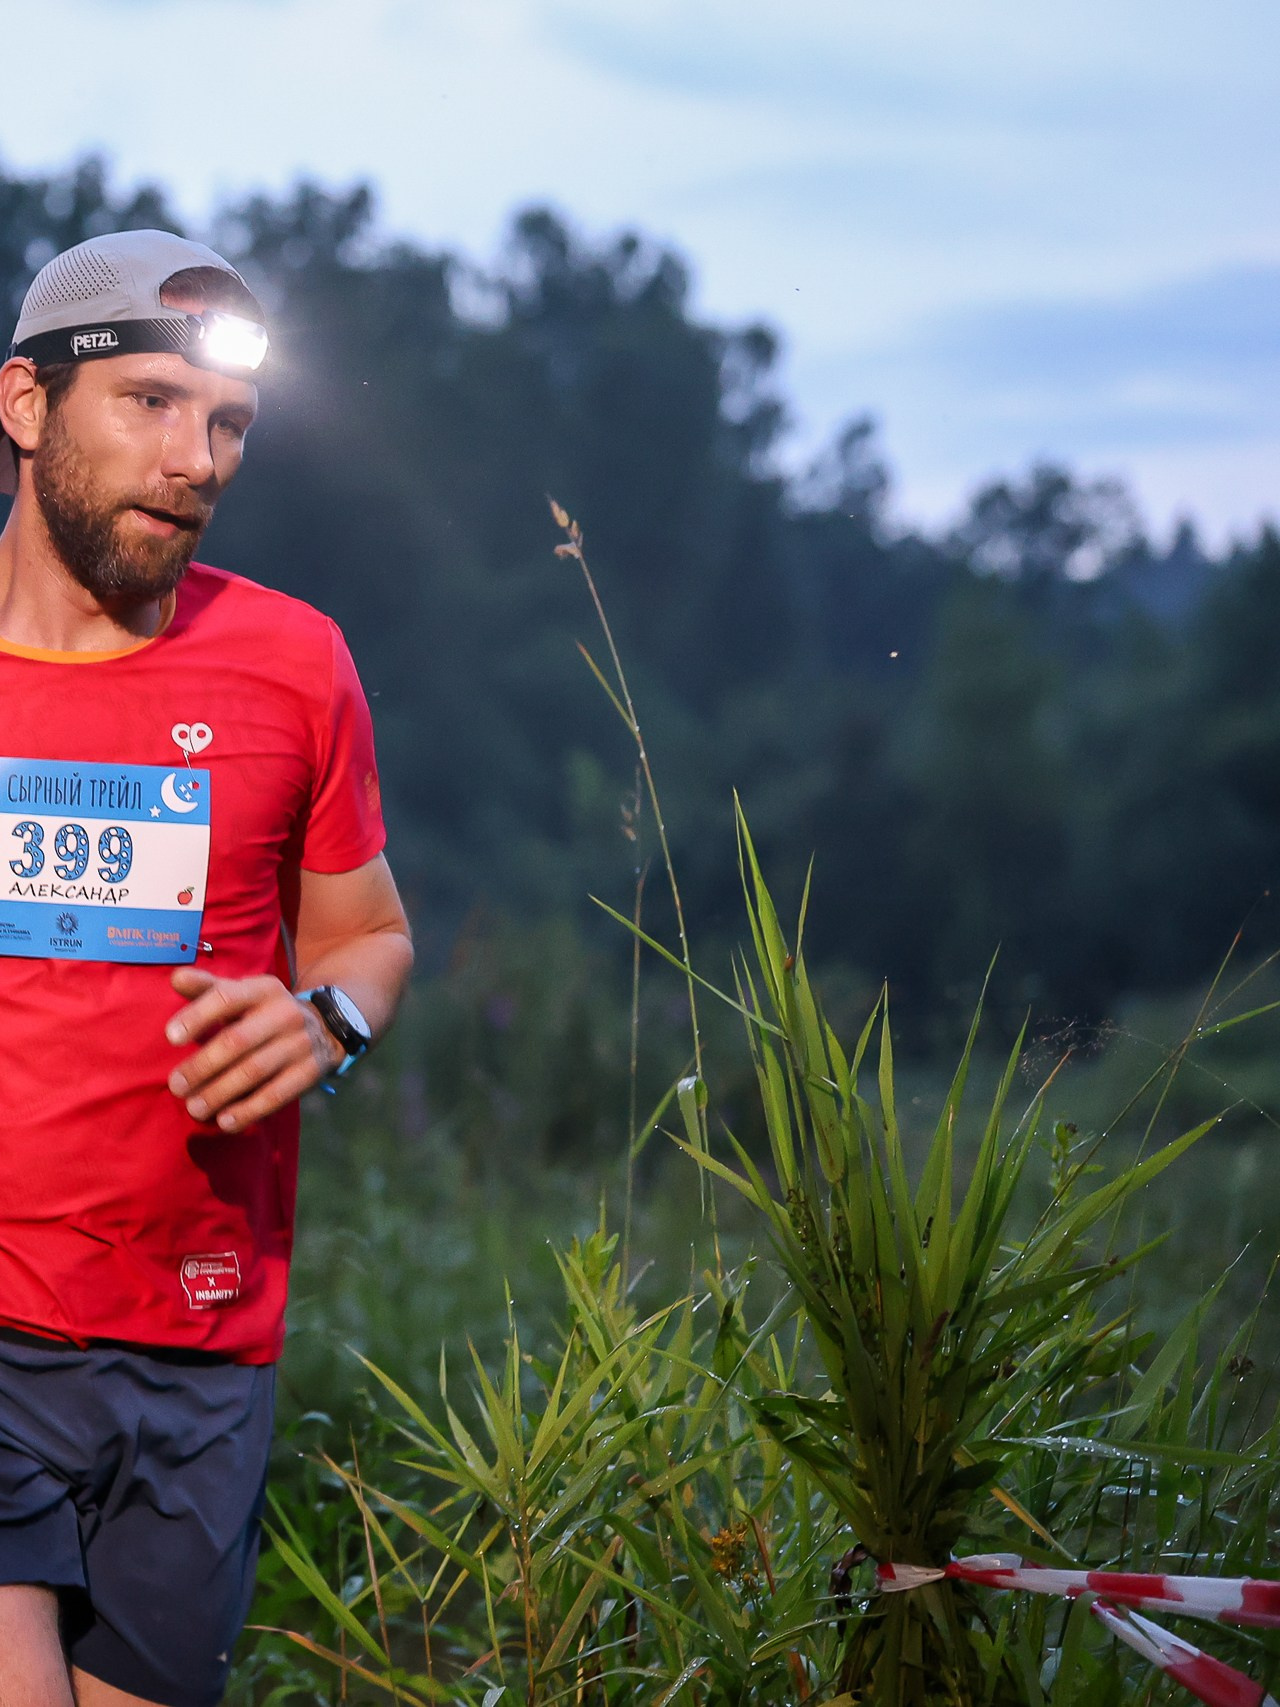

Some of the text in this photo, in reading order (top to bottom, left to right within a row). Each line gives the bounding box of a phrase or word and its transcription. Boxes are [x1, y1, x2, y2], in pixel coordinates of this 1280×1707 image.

[73, 332, 119, 356] PETZL
[8, 772, 142, 810] СЫРНЫЙ ТРЕЙЛ
[9, 821, 133, 884] 399
[9, 881, 130, 905] АЛЕКСАНДР
[49, 937, 83, 949] ISTRUN
[195, 1288, 234, 1301] INSANITY
